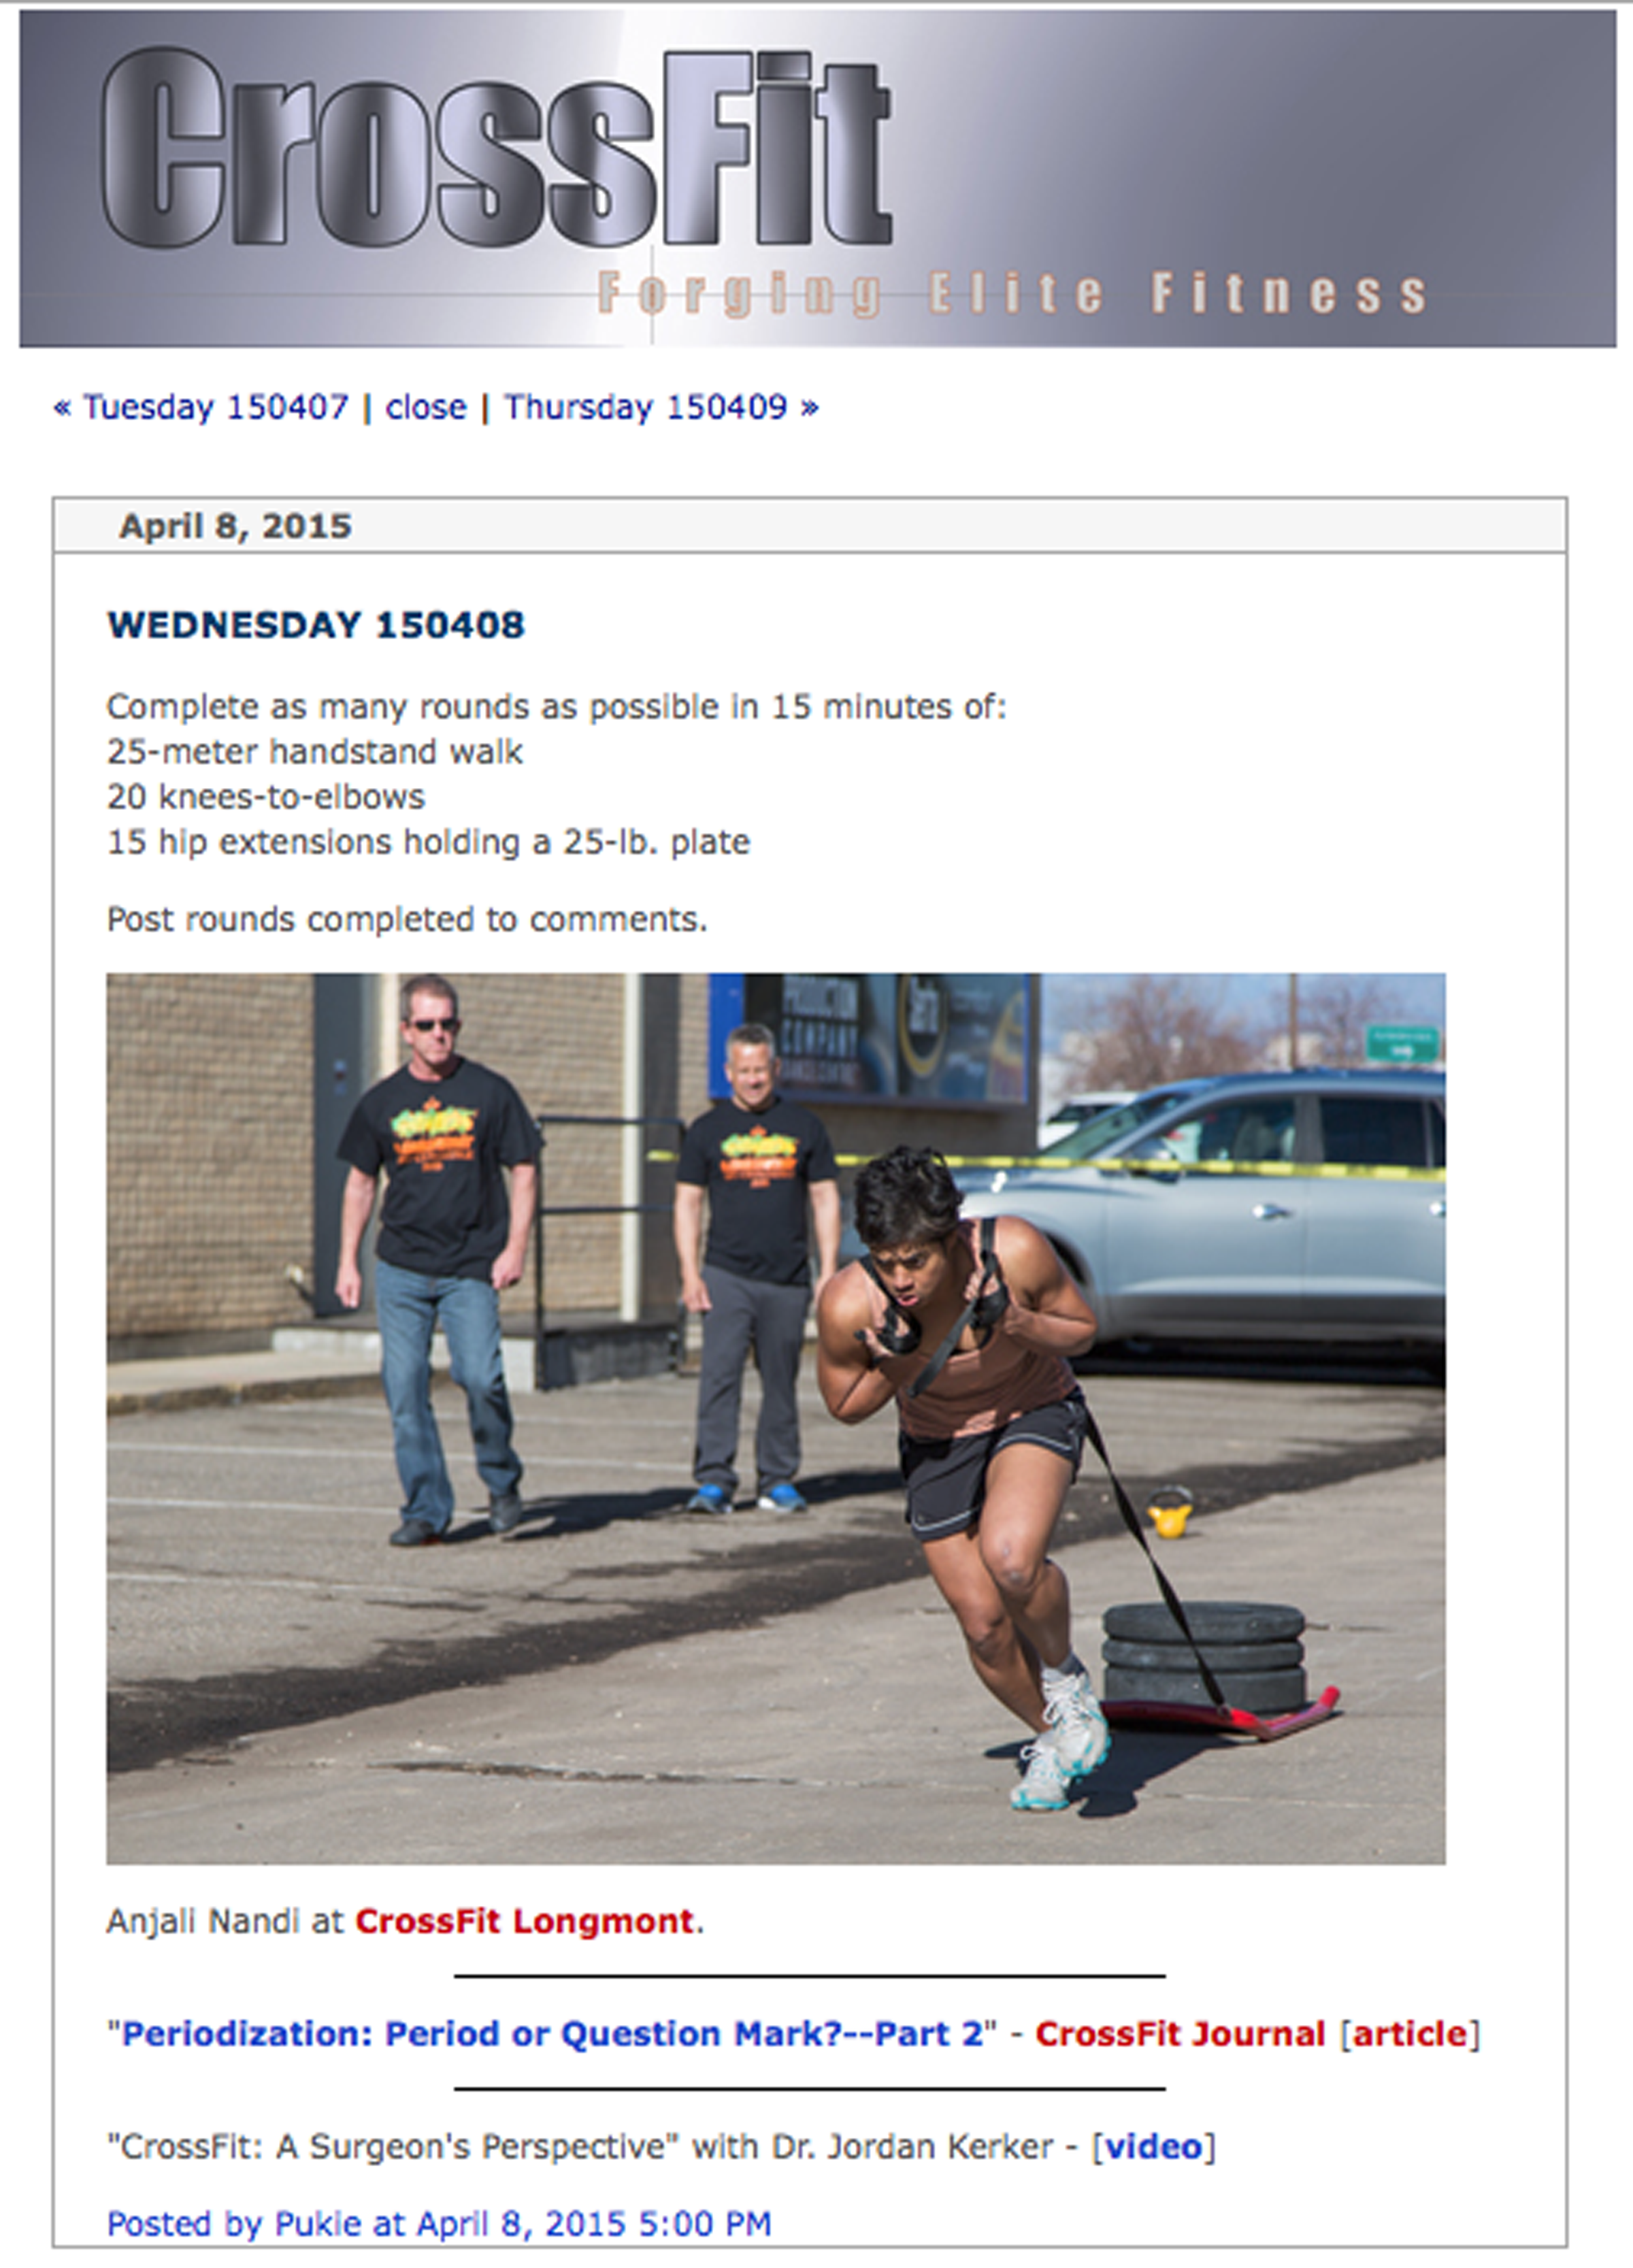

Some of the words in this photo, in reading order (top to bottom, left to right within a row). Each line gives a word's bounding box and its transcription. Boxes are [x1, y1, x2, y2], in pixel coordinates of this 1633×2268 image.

[100, 45, 893, 250] CrossFit
[597, 270, 880, 318] Forging
[929, 270, 1104, 314] Elite
[1151, 270, 1427, 314] Fitness
[82, 392, 216, 427] Tuesday
[228, 392, 350, 421] 150407
[385, 392, 469, 421] close
[504, 392, 655, 427] Thursday
[668, 392, 788, 421] 150409
[118, 511, 204, 546] April
[214, 512, 250, 546] 8,
[262, 512, 352, 540] 2015
[105, 610, 363, 640] WEDNESDAY
[376, 610, 526, 640] 150408
[105, 692, 260, 726] Complete
[269, 697, 308, 720] as
[318, 697, 409, 726] many
[420, 692, 530, 720] rounds
[540, 697, 578, 720] as
[589, 692, 720, 726] possible
[731, 692, 759, 719] in
[772, 692, 812, 720] 15
[823, 692, 954, 720] minutes
[962, 691, 1006, 720] of:
[106, 737, 259, 765] 25-meter
[269, 737, 437, 765] handstand
[449, 737, 524, 765] walk
[106, 782, 147, 810] 20
[159, 782, 427, 810] knees-to-elbows
[108, 827, 146, 855] 15
[159, 827, 208, 861] hip
[218, 827, 393, 855] extensions
[404, 827, 520, 861] holding
[531, 833, 552, 855] a
[563, 827, 658, 855] 25-lb.
[671, 827, 752, 861] plate
[108, 905, 176, 932] Post
[186, 904, 297, 932] rounds
[306, 904, 475, 938] completed
[485, 907, 519, 932] to
[529, 907, 708, 932] comments.
[105, 1907, 195, 1941] Anjali
[208, 1907, 300, 1935] Nandi
[311, 1909, 346, 1935] at
[354, 1906, 501, 1935] CrossFit
[513, 1907, 704, 1941] Longmont.
[106, 2018, 372, 2048] "Periodization:
[385, 2018, 500, 2048] Period
[511, 2025, 552, 2048] or
[560, 2018, 722, 2054] Question
[734, 2018, 951, 2048] Mark?--Part
[962, 2019, 997, 2048] 2"
[1035, 2018, 1183, 2048] CrossFit
[1191, 2019, 1325, 2048] Journal
[1339, 2018, 1481, 2054] [article]
[106, 2132, 262, 2160] "CrossFit:
[275, 2133, 300, 2160] A
[309, 2132, 472, 2166] Surgeon's
[482, 2132, 680, 2166] Perspective"
[691, 2132, 759, 2160] with
[772, 2133, 816, 2160] Dr.
[827, 2132, 936, 2160] Jordan
[948, 2132, 1055, 2160] Kerker
[1091, 2131, 1216, 2166] [video]
[108, 2209, 212, 2237] Posted
[225, 2209, 265, 2244] by
[276, 2209, 363, 2237] Pukie
[372, 2212, 407, 2237] at
[415, 2209, 489, 2243] April
[501, 2209, 533, 2243] 8,
[546, 2209, 627, 2237] 2015
[640, 2209, 714, 2237] 5:00
[727, 2209, 772, 2237] PM
